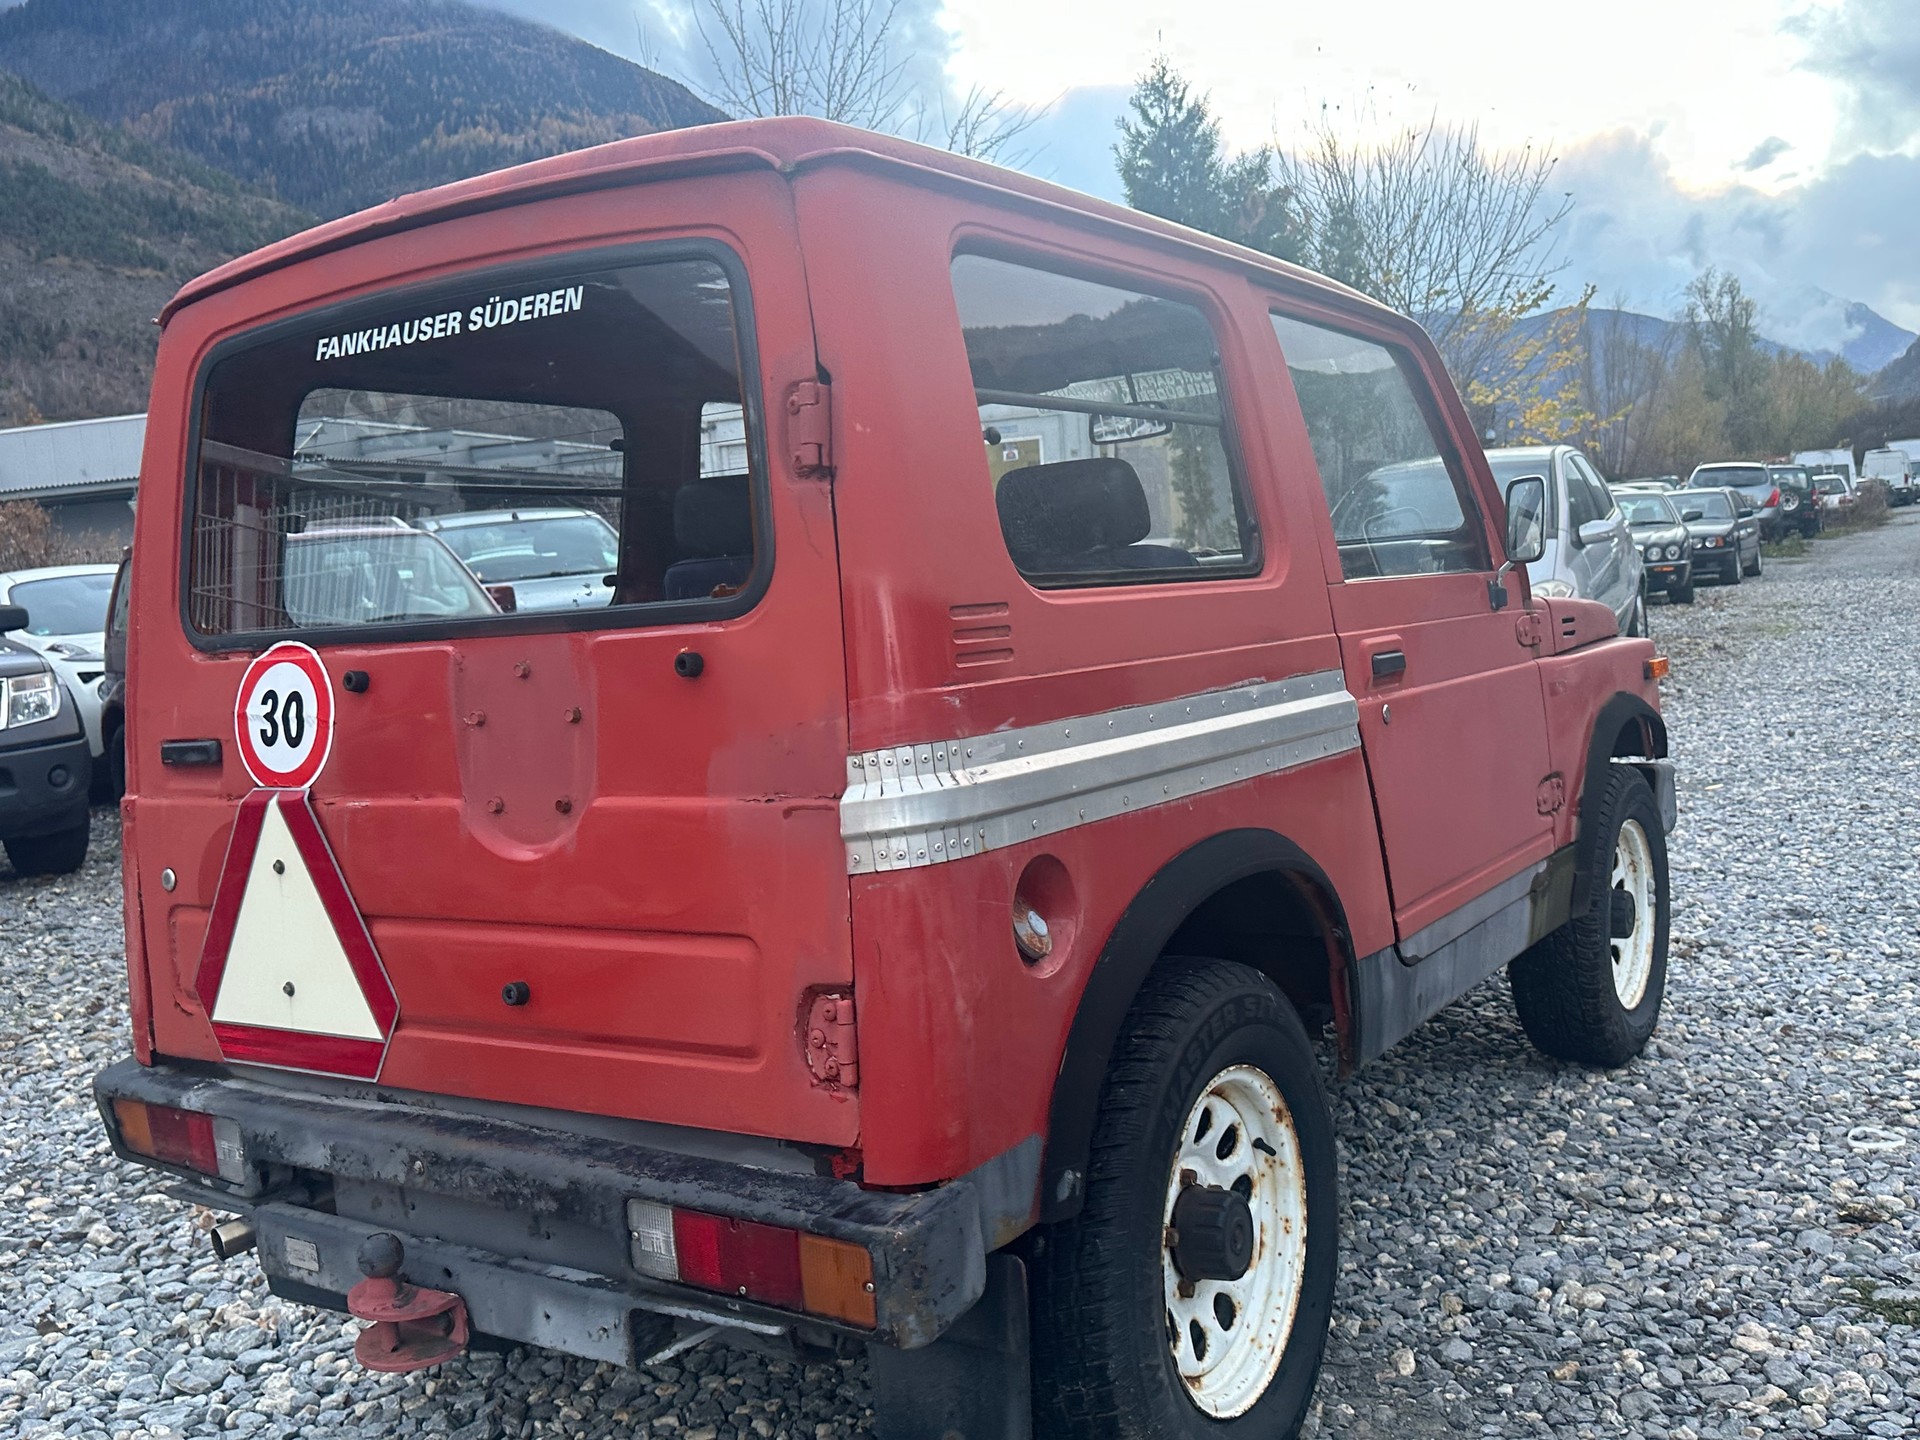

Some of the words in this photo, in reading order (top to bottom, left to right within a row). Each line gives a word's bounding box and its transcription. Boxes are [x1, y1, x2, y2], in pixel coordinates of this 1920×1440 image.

[316, 311, 462, 361] FANKHAUSER
[468, 286, 583, 331] SÜDEREN
[260, 689, 304, 748] 30
[1163, 1004, 1237, 1129] MASTER
